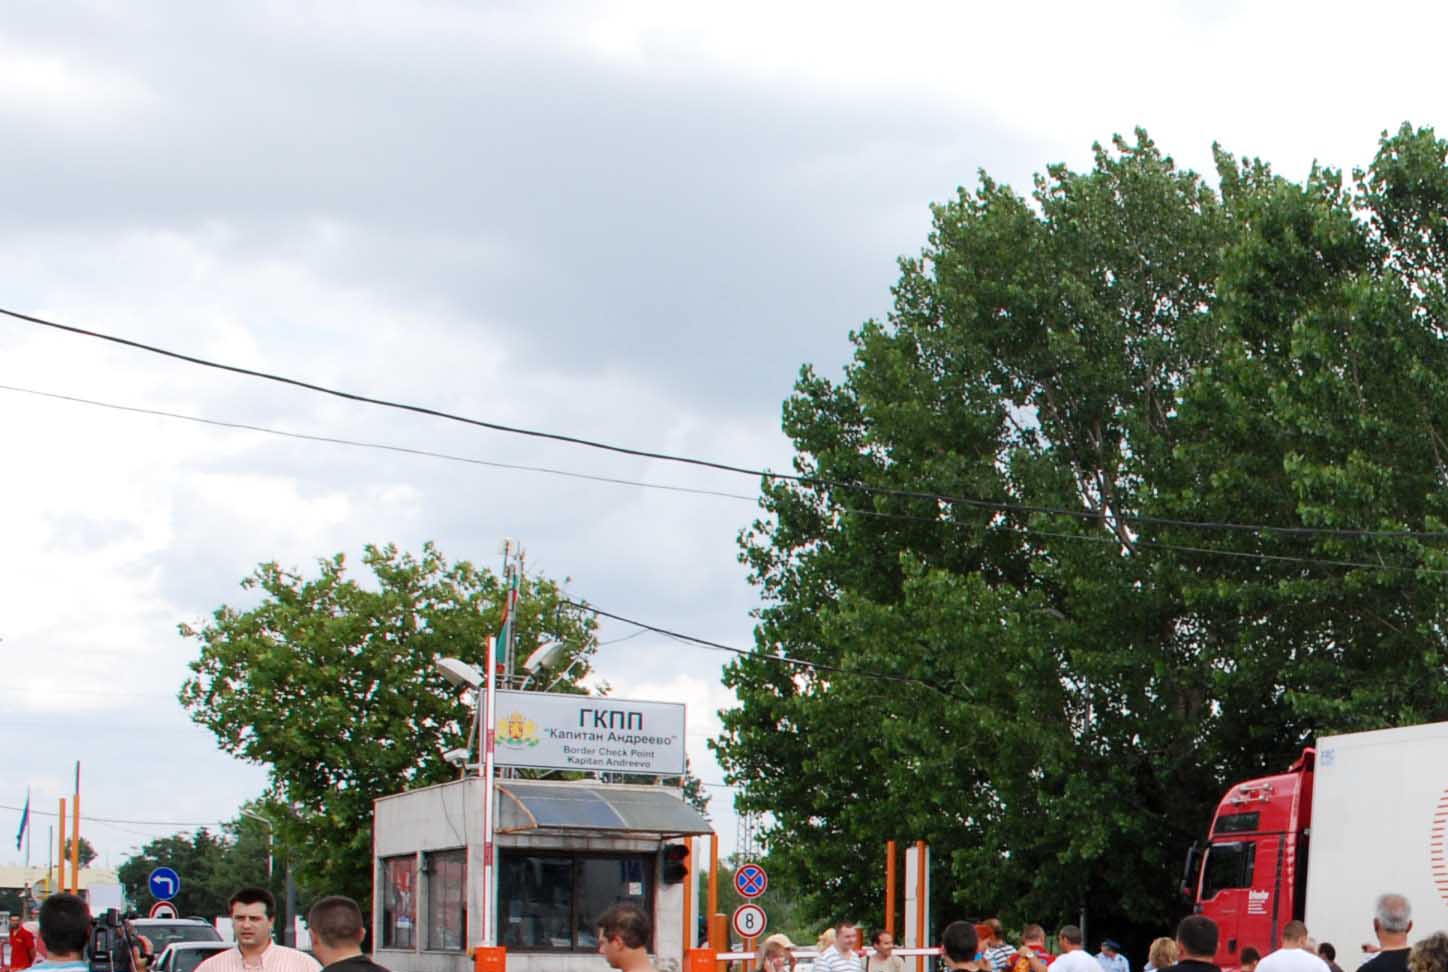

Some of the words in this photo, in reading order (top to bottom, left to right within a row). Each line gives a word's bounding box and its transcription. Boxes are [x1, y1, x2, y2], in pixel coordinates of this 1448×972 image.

[580, 708, 643, 729] ГКПП
[563, 745, 596, 754] Border
[599, 747, 628, 756] Check
[631, 749, 656, 758] Point
[606, 758, 651, 769] Andreevo
[745, 913, 754, 929] 8
